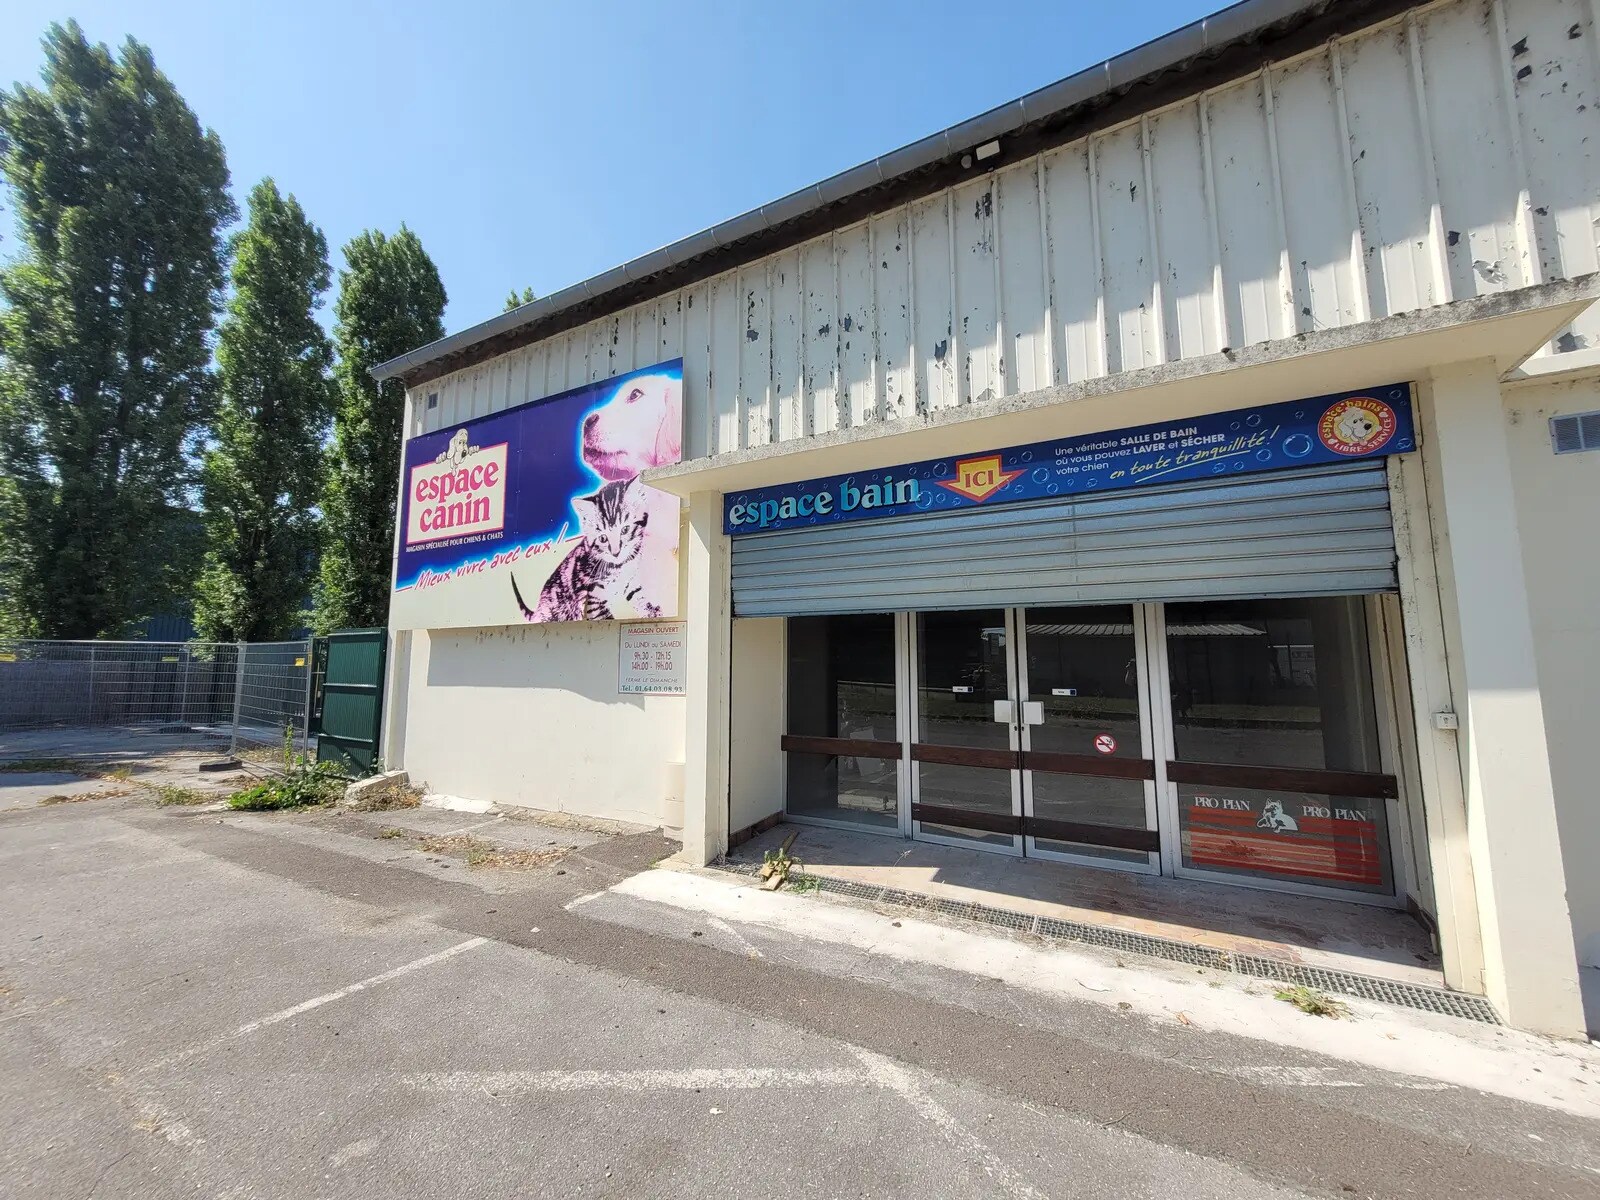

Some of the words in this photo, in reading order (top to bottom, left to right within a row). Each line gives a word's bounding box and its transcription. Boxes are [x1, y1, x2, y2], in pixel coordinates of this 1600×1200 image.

[1322, 405, 1344, 439] espace
[1344, 399, 1383, 412] bains
[1055, 446, 1073, 457] Une
[1075, 439, 1118, 453] véritable
[1120, 433, 1150, 446] SALLE
[1153, 432, 1167, 441] DE
[1170, 427, 1197, 439] BAIN
[1055, 454, 1068, 466] où
[1070, 453, 1092, 464] vous
[1094, 449, 1131, 462] pouvez
[1133, 442, 1166, 455] LAVER
[1168, 441, 1179, 449] et
[1181, 433, 1225, 448] SÉCHER
[965, 470, 994, 488] ICI
[1056, 465, 1080, 475] votre
[1082, 462, 1109, 472] chien
[1109, 470, 1125, 480] en
[1130, 458, 1171, 476] toute
[415, 461, 499, 503] espace
[419, 492, 491, 533] canin
[729, 491, 834, 528] espace
[839, 475, 921, 512] bain
[449, 537, 463, 546] POUR
[463, 534, 481, 544] CHIENS
[482, 533, 487, 541] &
[487, 531, 504, 540] CHATS
[415, 570, 452, 590] Mieux
[456, 561, 487, 578] vivre
[490, 547, 521, 569] avec
[660, 640, 681, 648] SAMEDI
[1194, 796, 1219, 809] PRO
[1223, 798, 1250, 811] PLAN
[1302, 805, 1331, 818] PRO
[1335, 808, 1367, 822] PLAN
